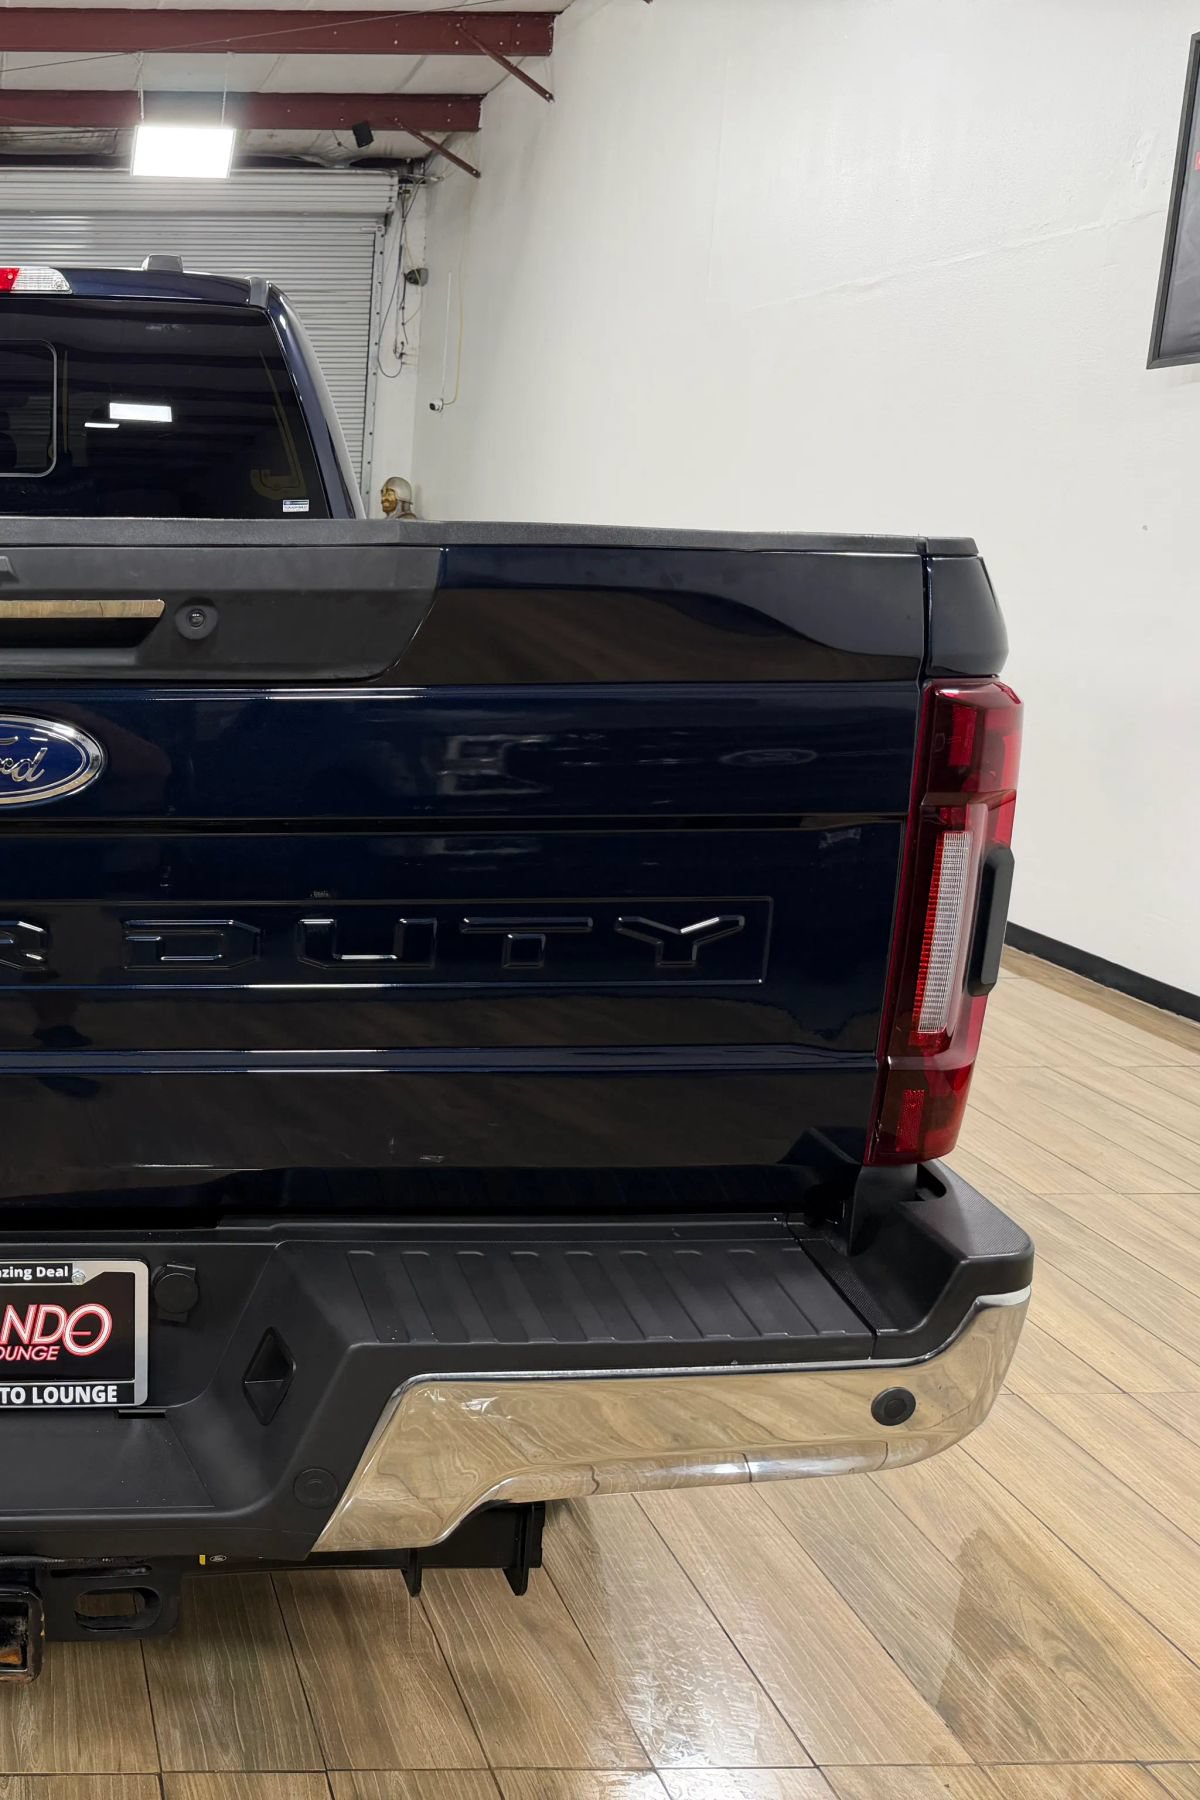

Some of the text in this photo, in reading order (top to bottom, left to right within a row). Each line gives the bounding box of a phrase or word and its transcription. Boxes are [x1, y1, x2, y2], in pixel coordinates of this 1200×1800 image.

[123, 914, 746, 971] DUTY
[36, 1265, 69, 1278] Deal
[32, 1385, 118, 1404] LOUNGE
